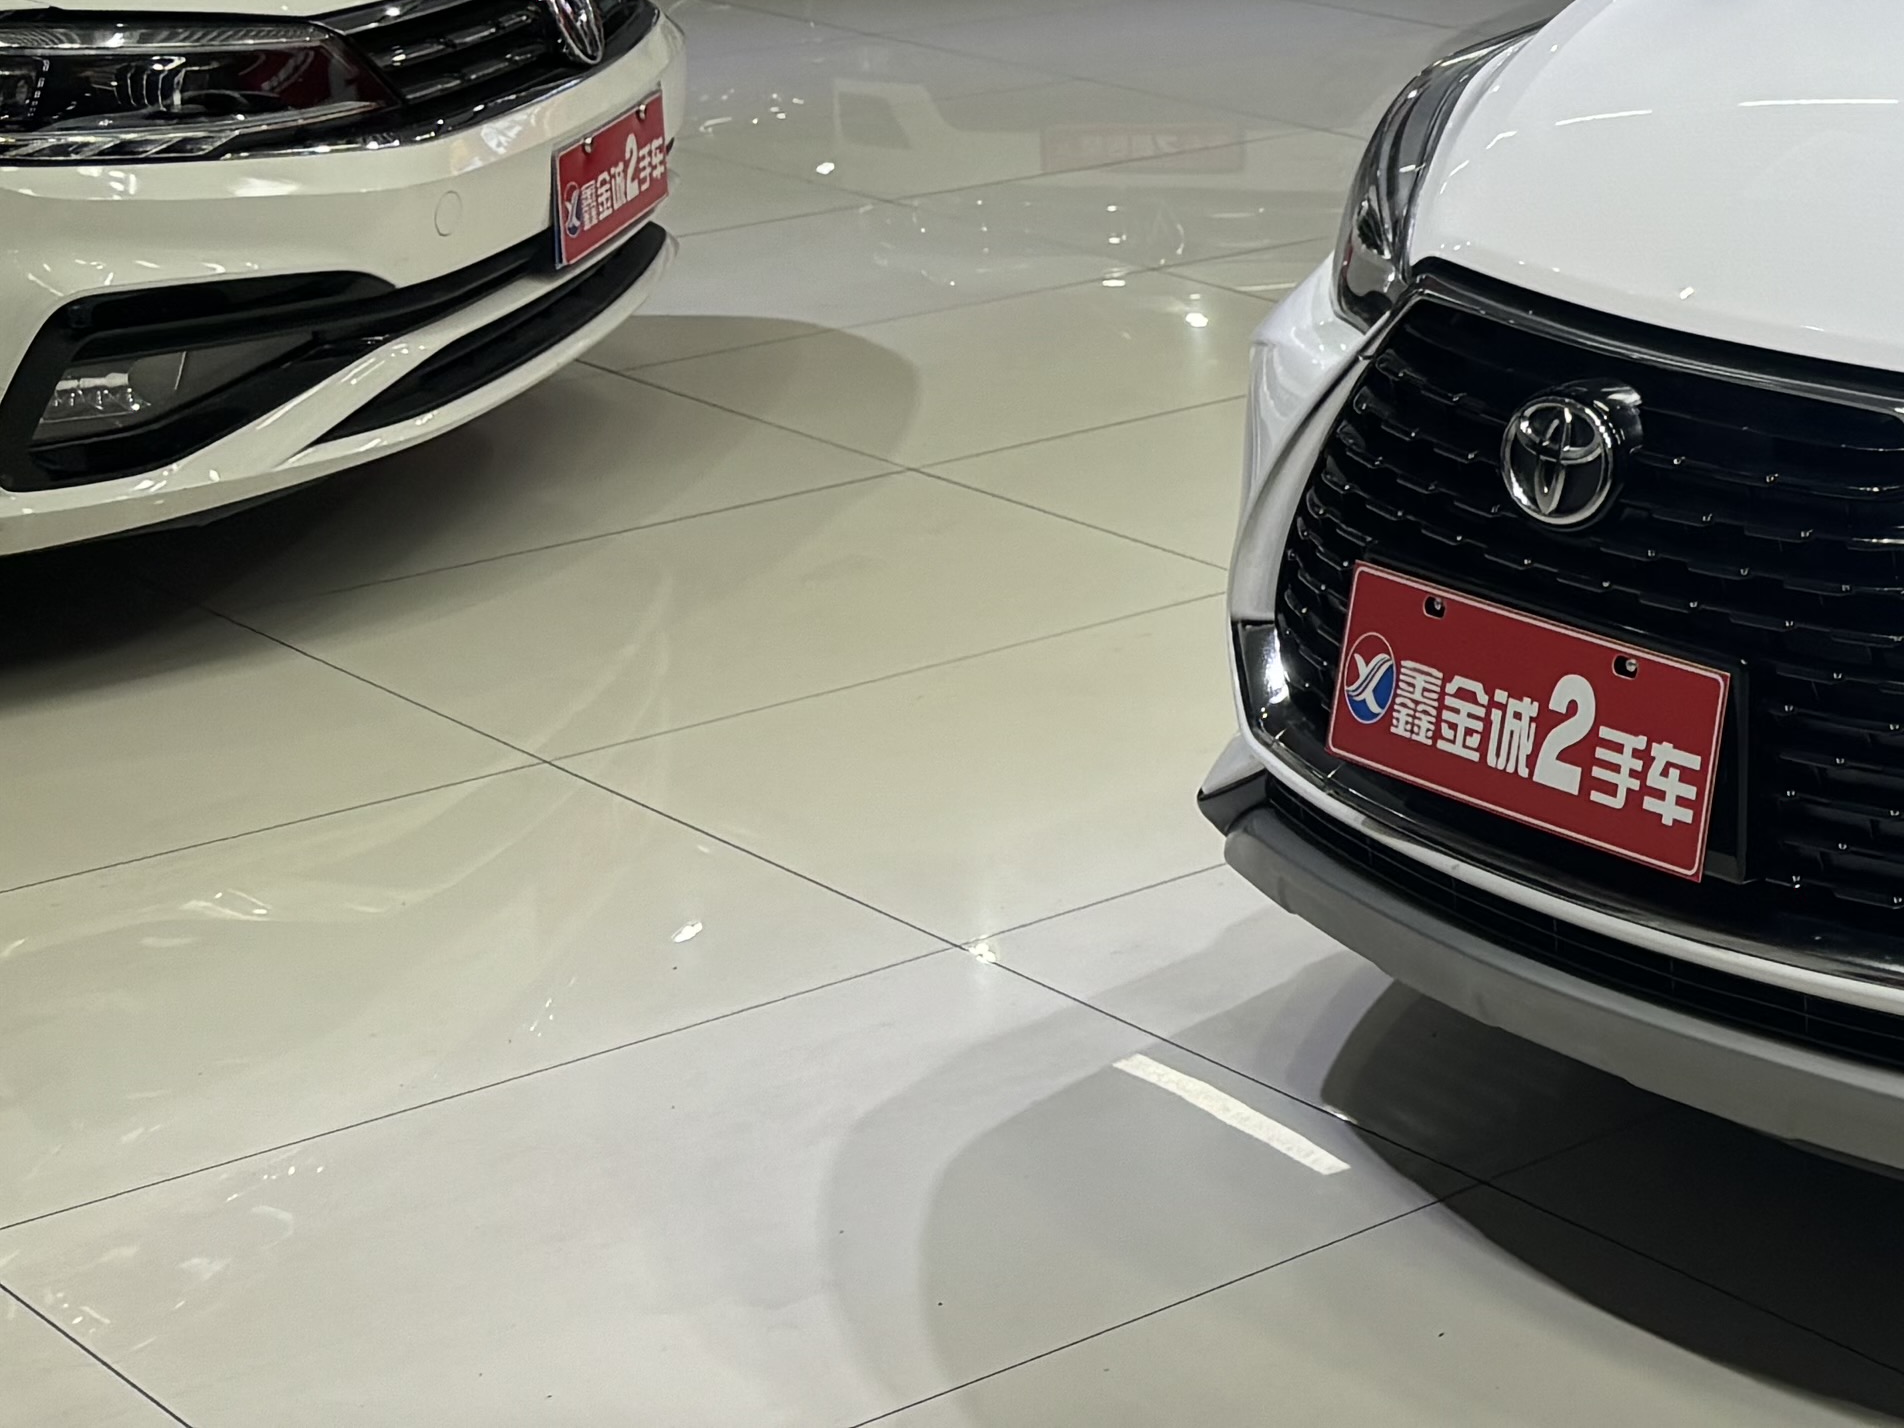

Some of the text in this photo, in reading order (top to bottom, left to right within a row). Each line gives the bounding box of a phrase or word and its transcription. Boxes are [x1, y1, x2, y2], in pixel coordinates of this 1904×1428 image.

[580, 133, 666, 230] 鑫金诚2手车
[1390, 659, 1701, 827] 鑫金诚2手车
